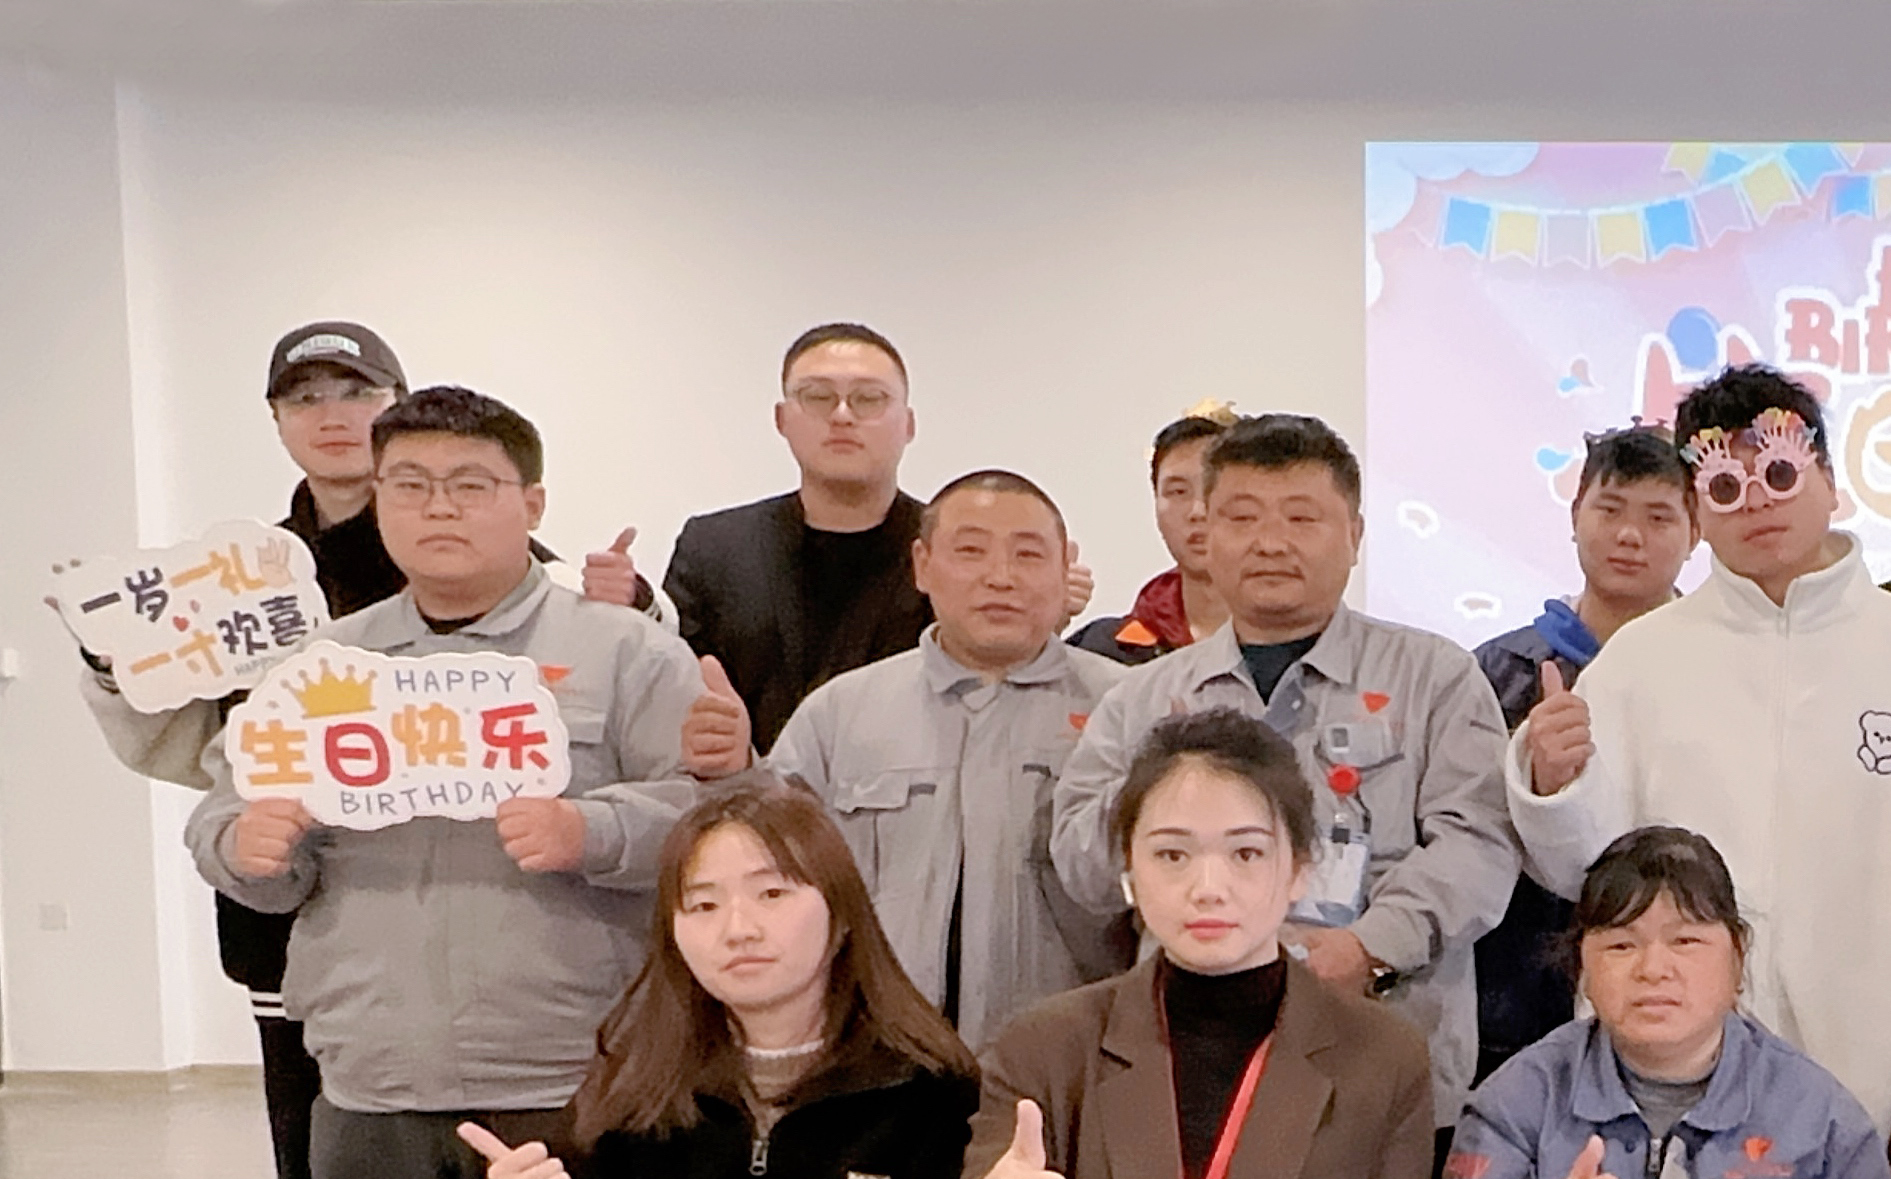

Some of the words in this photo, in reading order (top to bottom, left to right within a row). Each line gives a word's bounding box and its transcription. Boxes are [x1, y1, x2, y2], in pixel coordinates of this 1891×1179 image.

[80, 541, 266, 622] 一岁一礼
[394, 669, 517, 693] HAPPY
[239, 701, 551, 788] 生日快乐
[340, 784, 525, 816] BIRTHDAY
